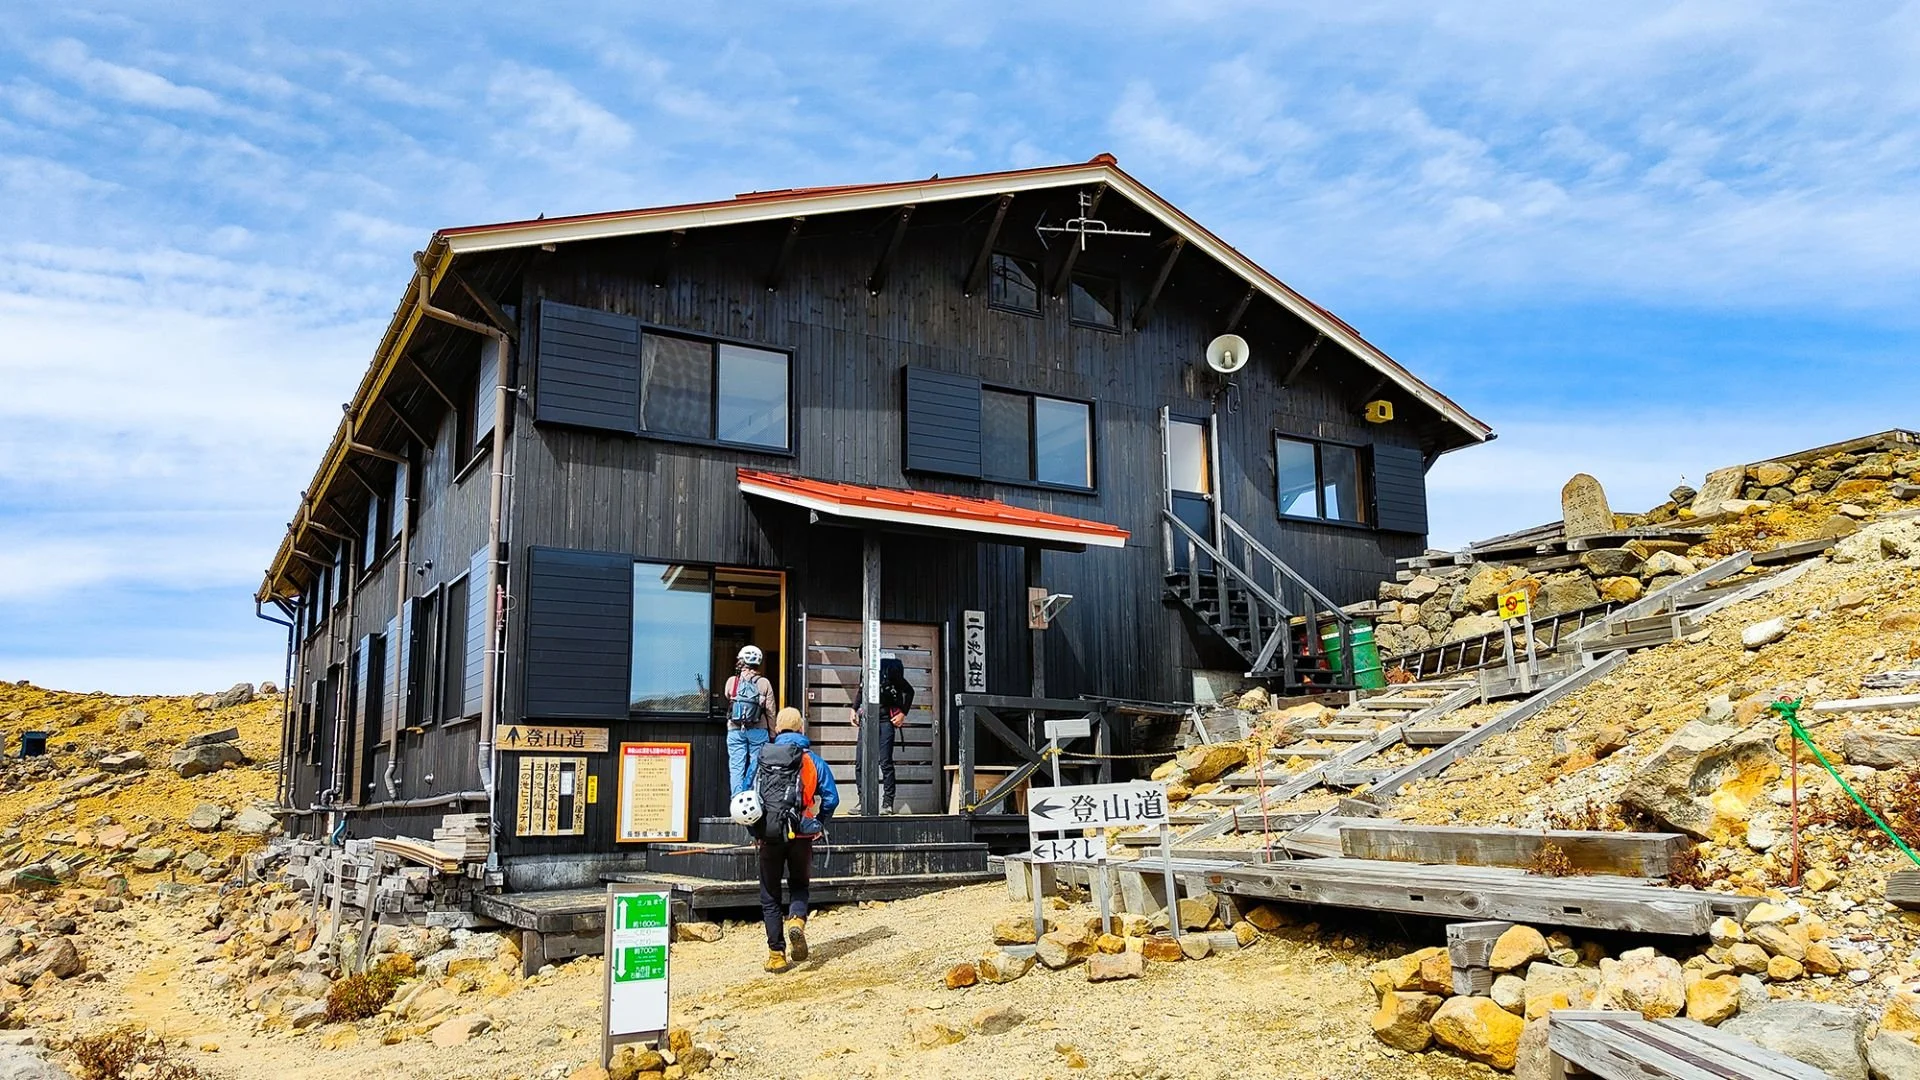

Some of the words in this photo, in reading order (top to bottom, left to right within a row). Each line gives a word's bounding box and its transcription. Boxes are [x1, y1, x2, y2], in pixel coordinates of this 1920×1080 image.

[966, 618, 984, 687] 二ノ池山荘
[523, 728, 586, 749] 登山道
[1068, 790, 1165, 824] 登山道
[1051, 839, 1097, 861] トイレ
